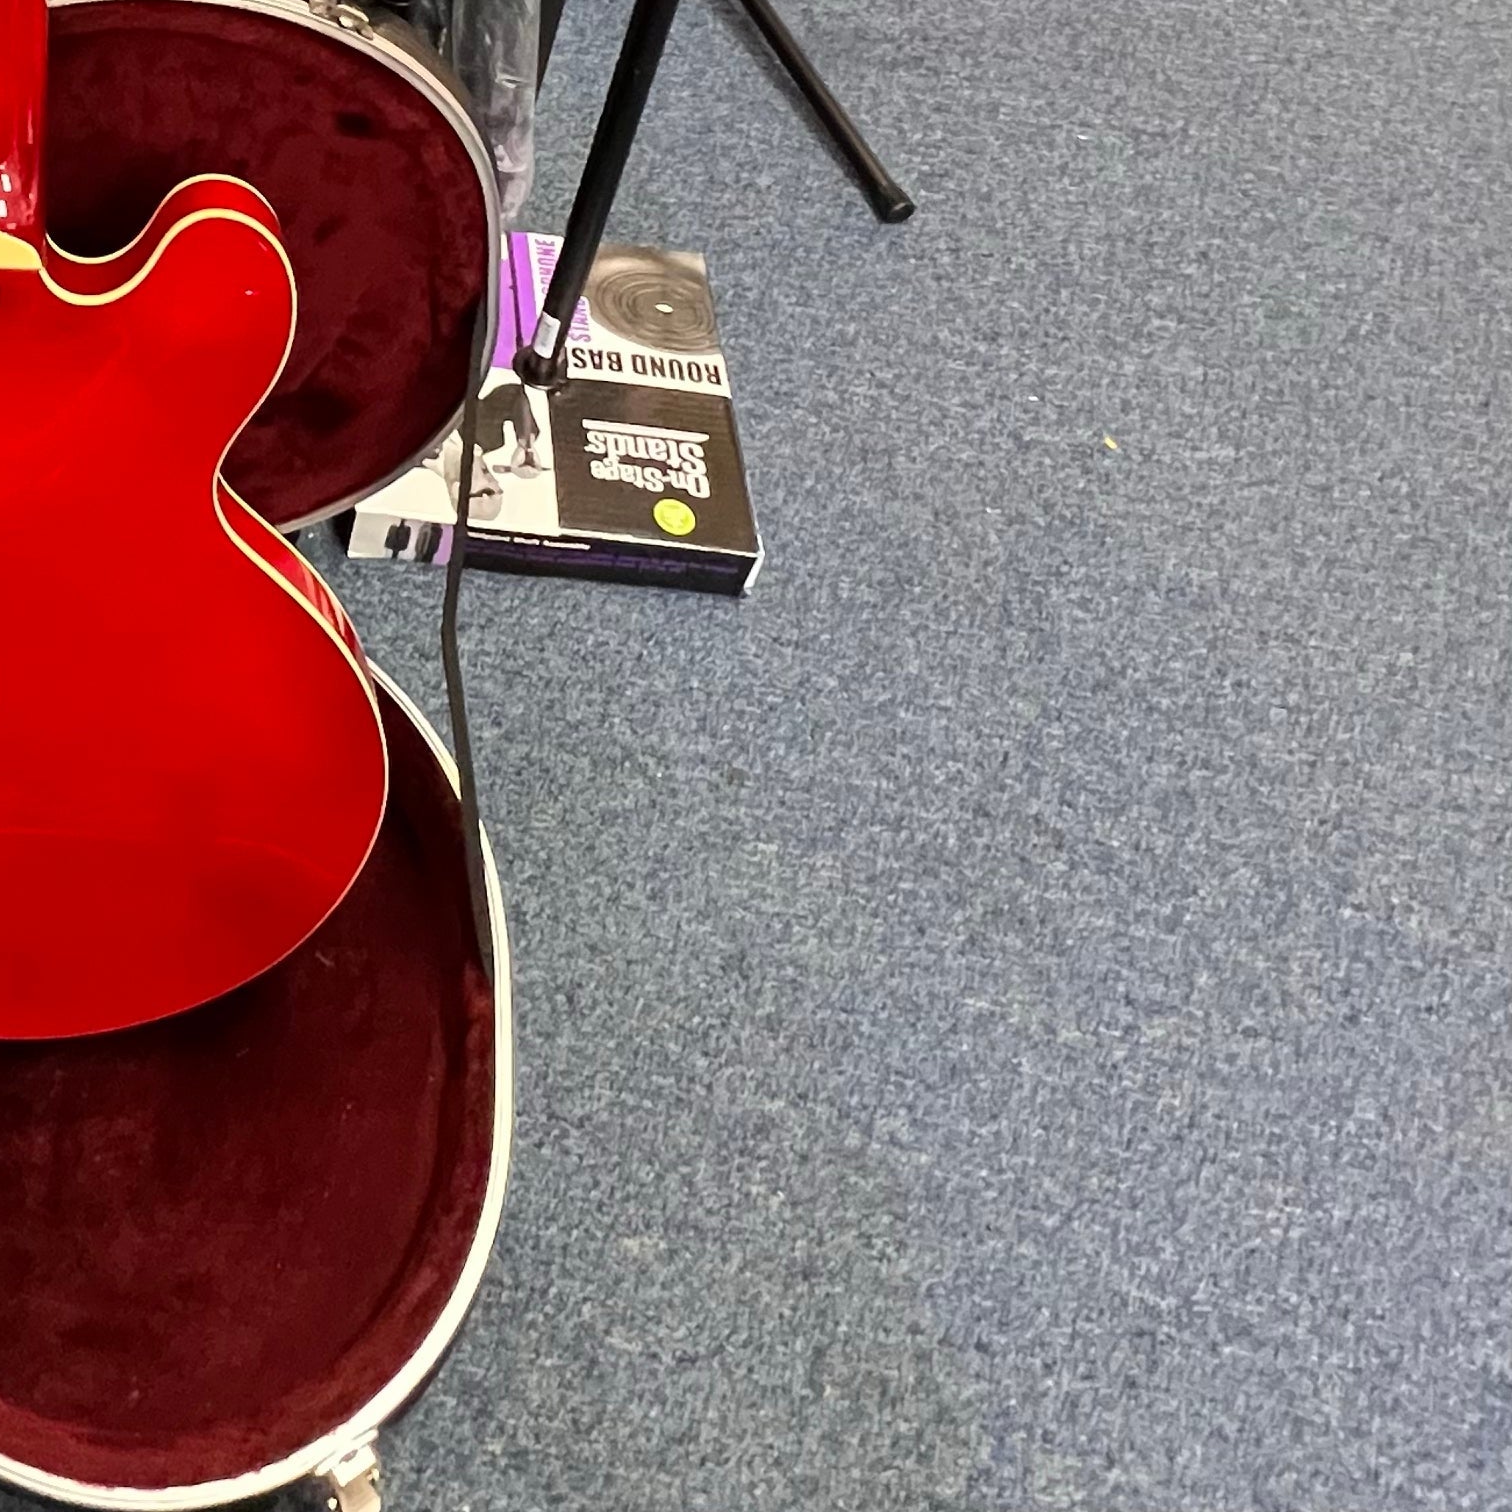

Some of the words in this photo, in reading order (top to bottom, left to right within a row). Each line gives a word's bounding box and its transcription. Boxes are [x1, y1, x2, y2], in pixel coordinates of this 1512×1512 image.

[567, 347, 624, 373] BAS
[631, 353, 722, 386] ROUND
[584, 430, 708, 474] Stands
[590, 458, 711, 499] On-Stage
